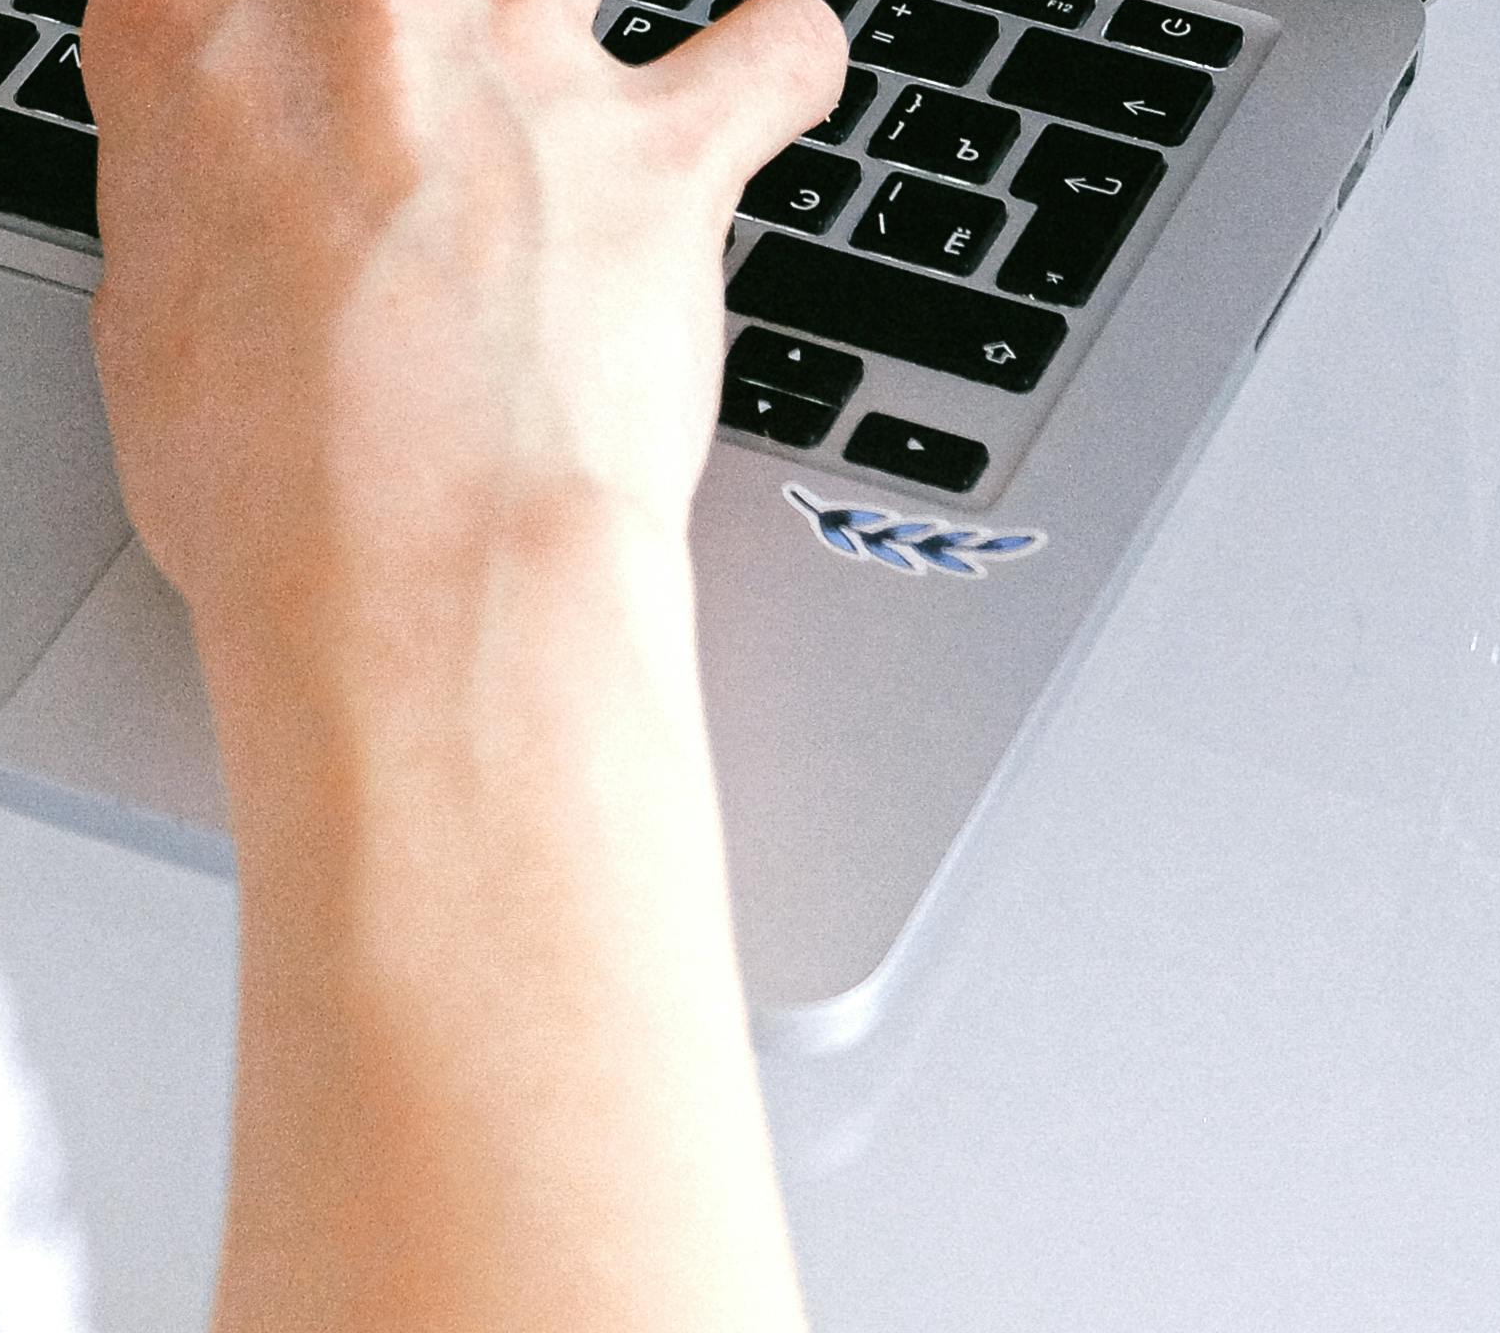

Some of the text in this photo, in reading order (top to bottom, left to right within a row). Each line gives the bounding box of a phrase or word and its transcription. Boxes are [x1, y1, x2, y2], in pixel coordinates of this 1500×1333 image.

[891, 2, 912, 17] +
[1046, 0, 1074, 13] F12
[623, 16, 651, 36] P
[871, 30, 895, 44] =
[905, 93, 923, 114] }
[956, 137, 980, 161] Ъ
[790, 189, 821, 211] Э
[943, 226, 972, 255] Ё
